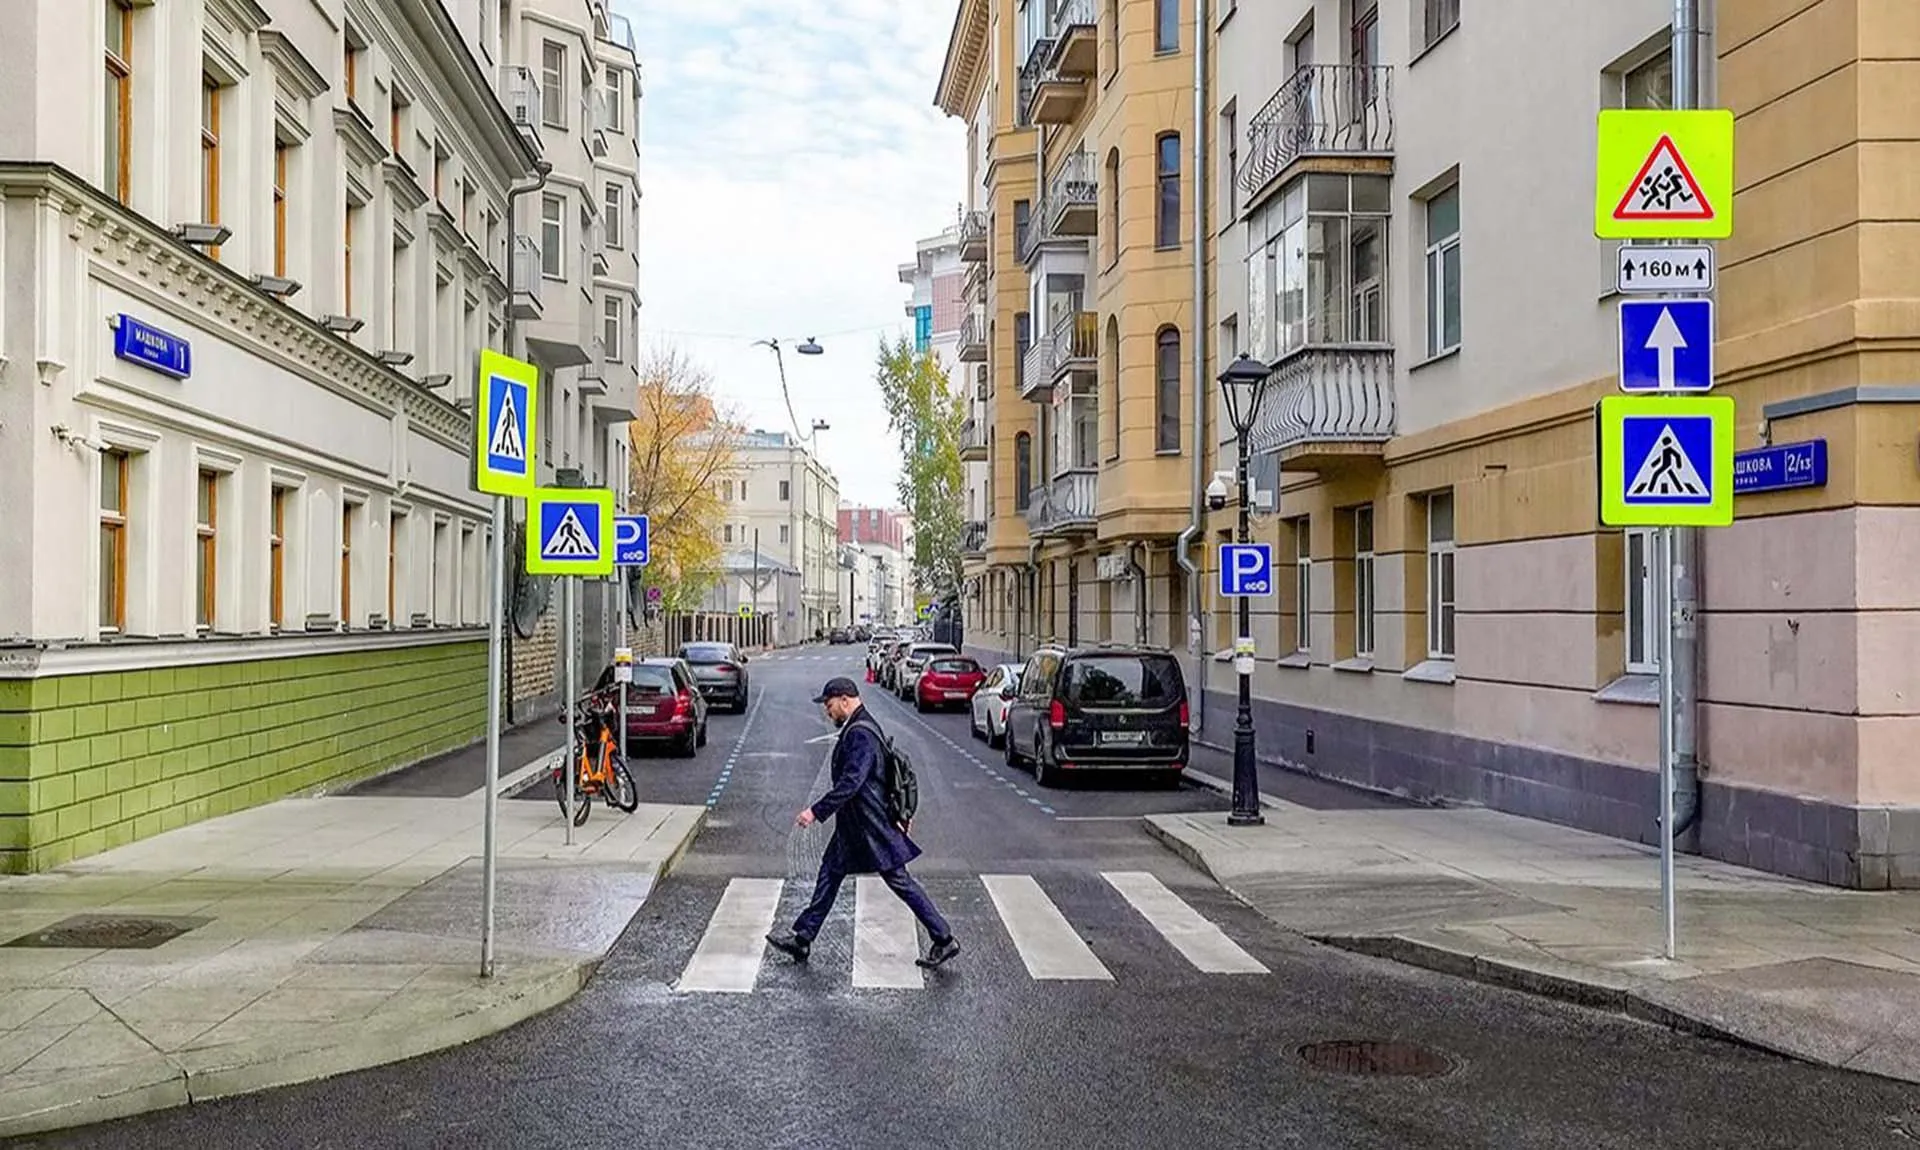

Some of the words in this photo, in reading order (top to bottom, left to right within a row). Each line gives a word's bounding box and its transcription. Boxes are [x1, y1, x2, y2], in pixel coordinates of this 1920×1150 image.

[1639, 261, 1672, 277] 160
[1675, 264, 1690, 277] м
[180, 346, 185, 369] 1
[1733, 456, 1772, 474] ШКОВА
[1787, 453, 1812, 473] 2/13
[614, 520, 641, 561] P
[1232, 548, 1264, 592] P
